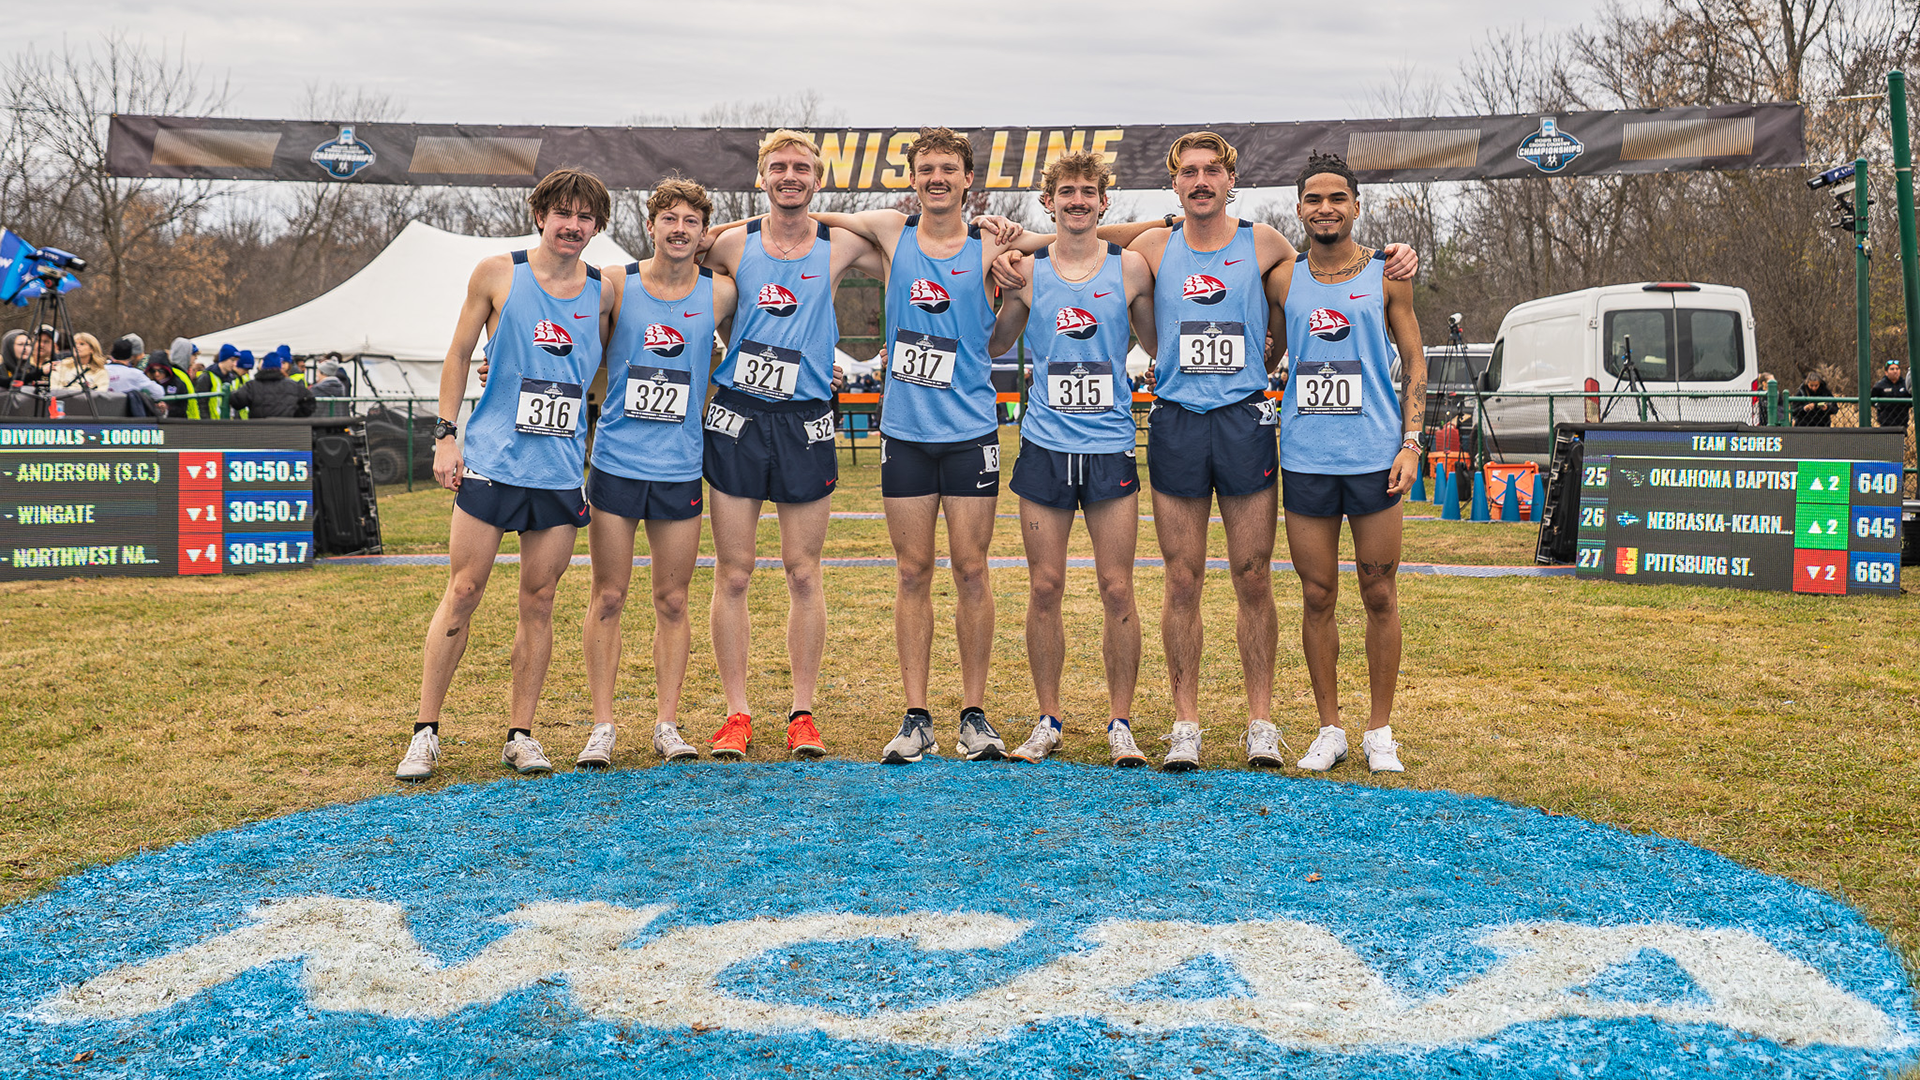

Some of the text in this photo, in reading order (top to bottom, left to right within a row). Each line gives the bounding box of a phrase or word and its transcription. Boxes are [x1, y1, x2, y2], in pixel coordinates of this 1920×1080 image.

[985, 129, 1124, 189] LINE
[1519, 145, 1581, 156] CHAMPIONSHIPS
[902, 348, 942, 380] 317
[1191, 338, 1233, 366] 319
[744, 360, 785, 392] 321
[635, 384, 678, 414] 322
[1059, 380, 1101, 406] 315
[1306, 379, 1350, 406] 320
[528, 398, 570, 428] 316
[706, 406, 736, 431] 321
[812, 414, 834, 439] 32
[100, 429, 165, 445] 10000M
[1692, 436, 1782, 452] TEAM SCORES
[16, 462, 110, 482] ANDERSON
[114, 462, 161, 484] (S.C.)
[205, 461, 217, 480] 3
[228, 460, 309, 483] 30:50.5
[1584, 466, 1898, 494] 25 OKLAHOMA BAPTIST 2 640
[17, 504, 96, 525] WINGATE
[206, 504, 217, 522] 1
[228, 500, 308, 522] 30:50.7
[1581, 507, 1605, 528] 26
[1826, 520, 1838, 535] 2
[1856, 516, 1896, 539] 645
[12, 546, 118, 568] NORTHWEST
[204, 543, 217, 562] 4
[228, 541, 308, 565] 30:51.7
[1578, 548, 1895, 584] 27 PITTSBURG ST. 2 663
[25, 895, 1905, 1050] NCAA
